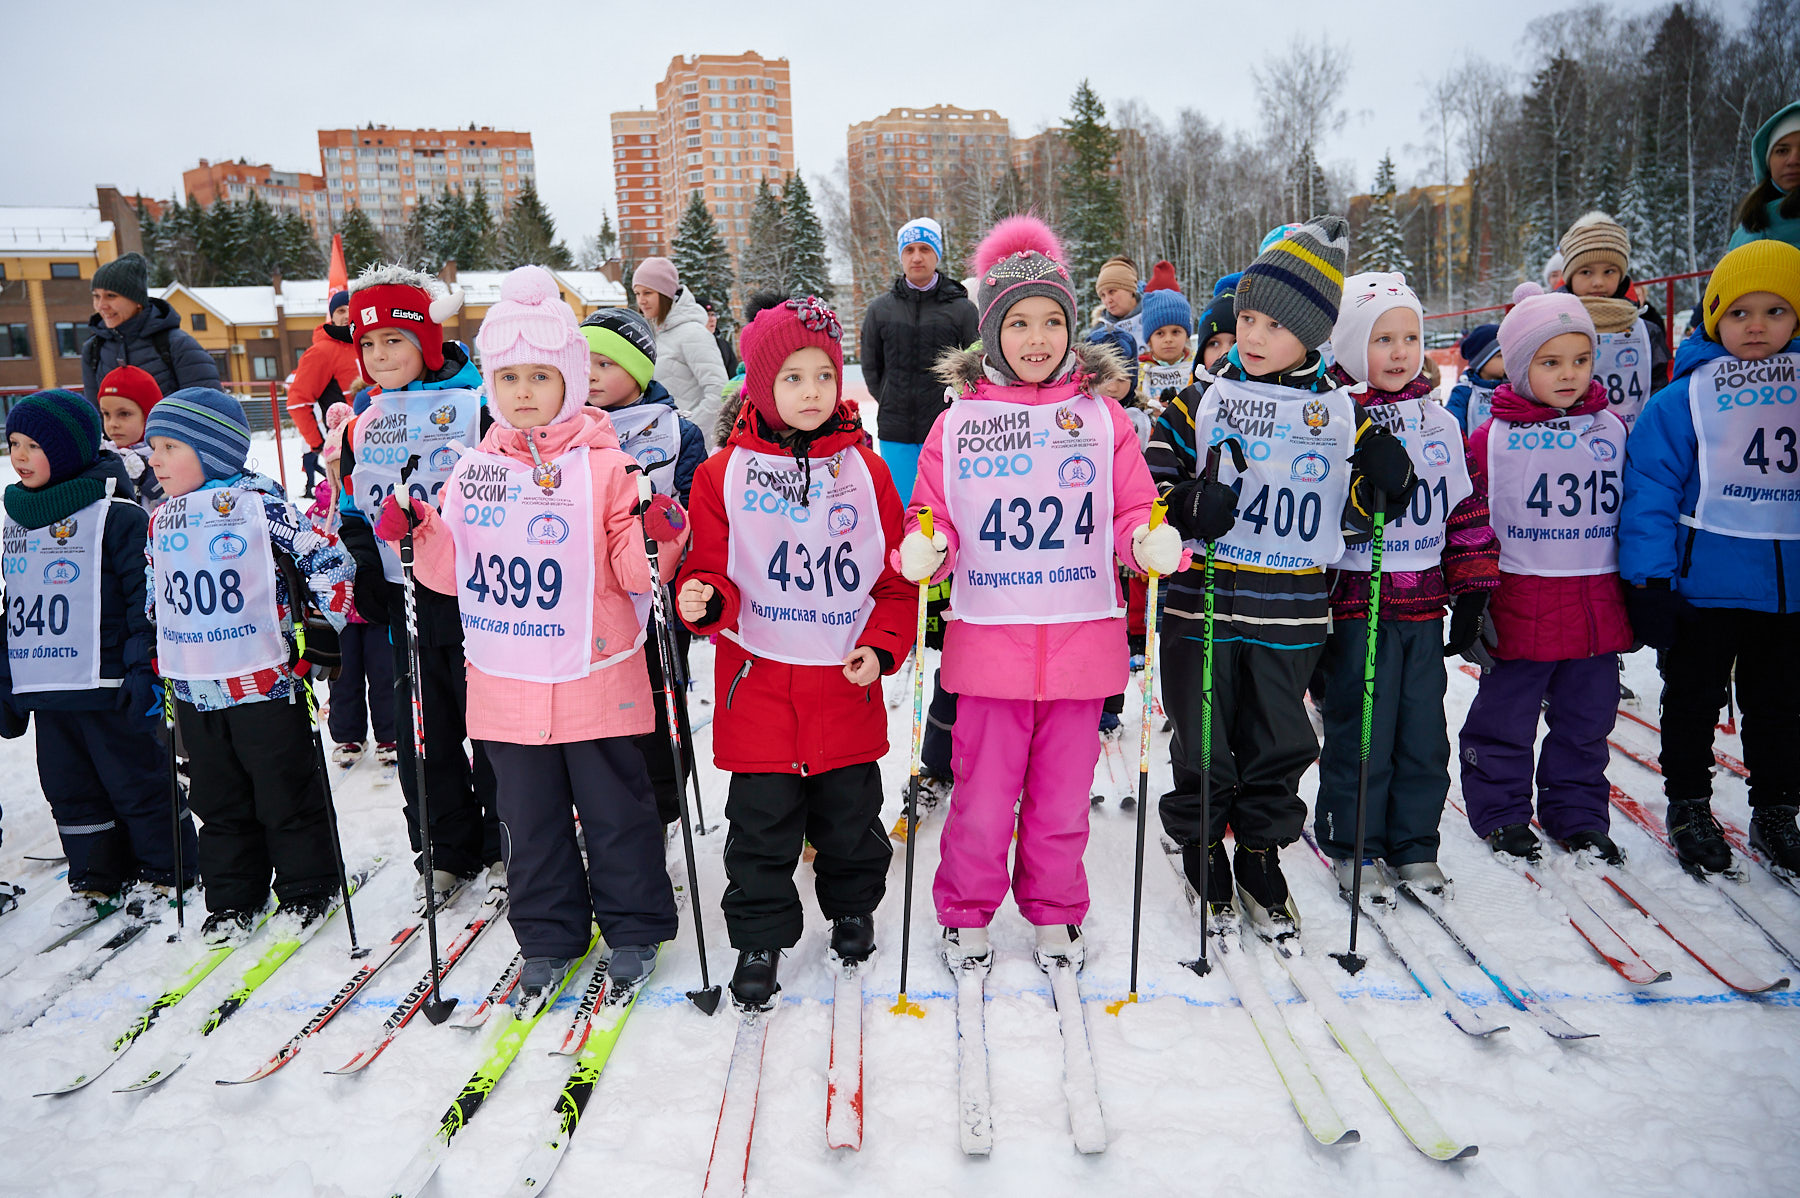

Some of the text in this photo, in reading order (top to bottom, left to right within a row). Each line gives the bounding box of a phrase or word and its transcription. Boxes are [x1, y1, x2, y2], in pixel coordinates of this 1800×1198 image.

[392, 309, 424, 322] Eisbär
[1714, 367, 1795, 392] РОССИИ
[1717, 385, 1798, 413] 2020
[365, 413, 408, 429] ЛЫЖНЯ
[956, 410, 1030, 436] ЛЫЖНЯ
[364, 427, 408, 445] РОССИИ
[958, 431, 1031, 454] РОССИИ
[1506, 432, 1578, 450] 2020
[362, 446, 409, 465] 2020
[958, 453, 1033, 480] 2020
[1526, 470, 1620, 517] 4315
[979, 491, 1095, 552] 4324
[1507, 525, 1580, 542] Калужская
[1266, 552, 1314, 568] область
[1371, 525, 1384, 582] NITRO
[768, 540, 860, 597] 4316
[968, 565, 1097, 589] Калужская область
[466, 552, 563, 611] 4399
[751, 599, 817, 623] Калужская
[163, 623, 257, 644] Калужская область
[513, 621, 565, 637] область
[32, 645, 78, 659] область
